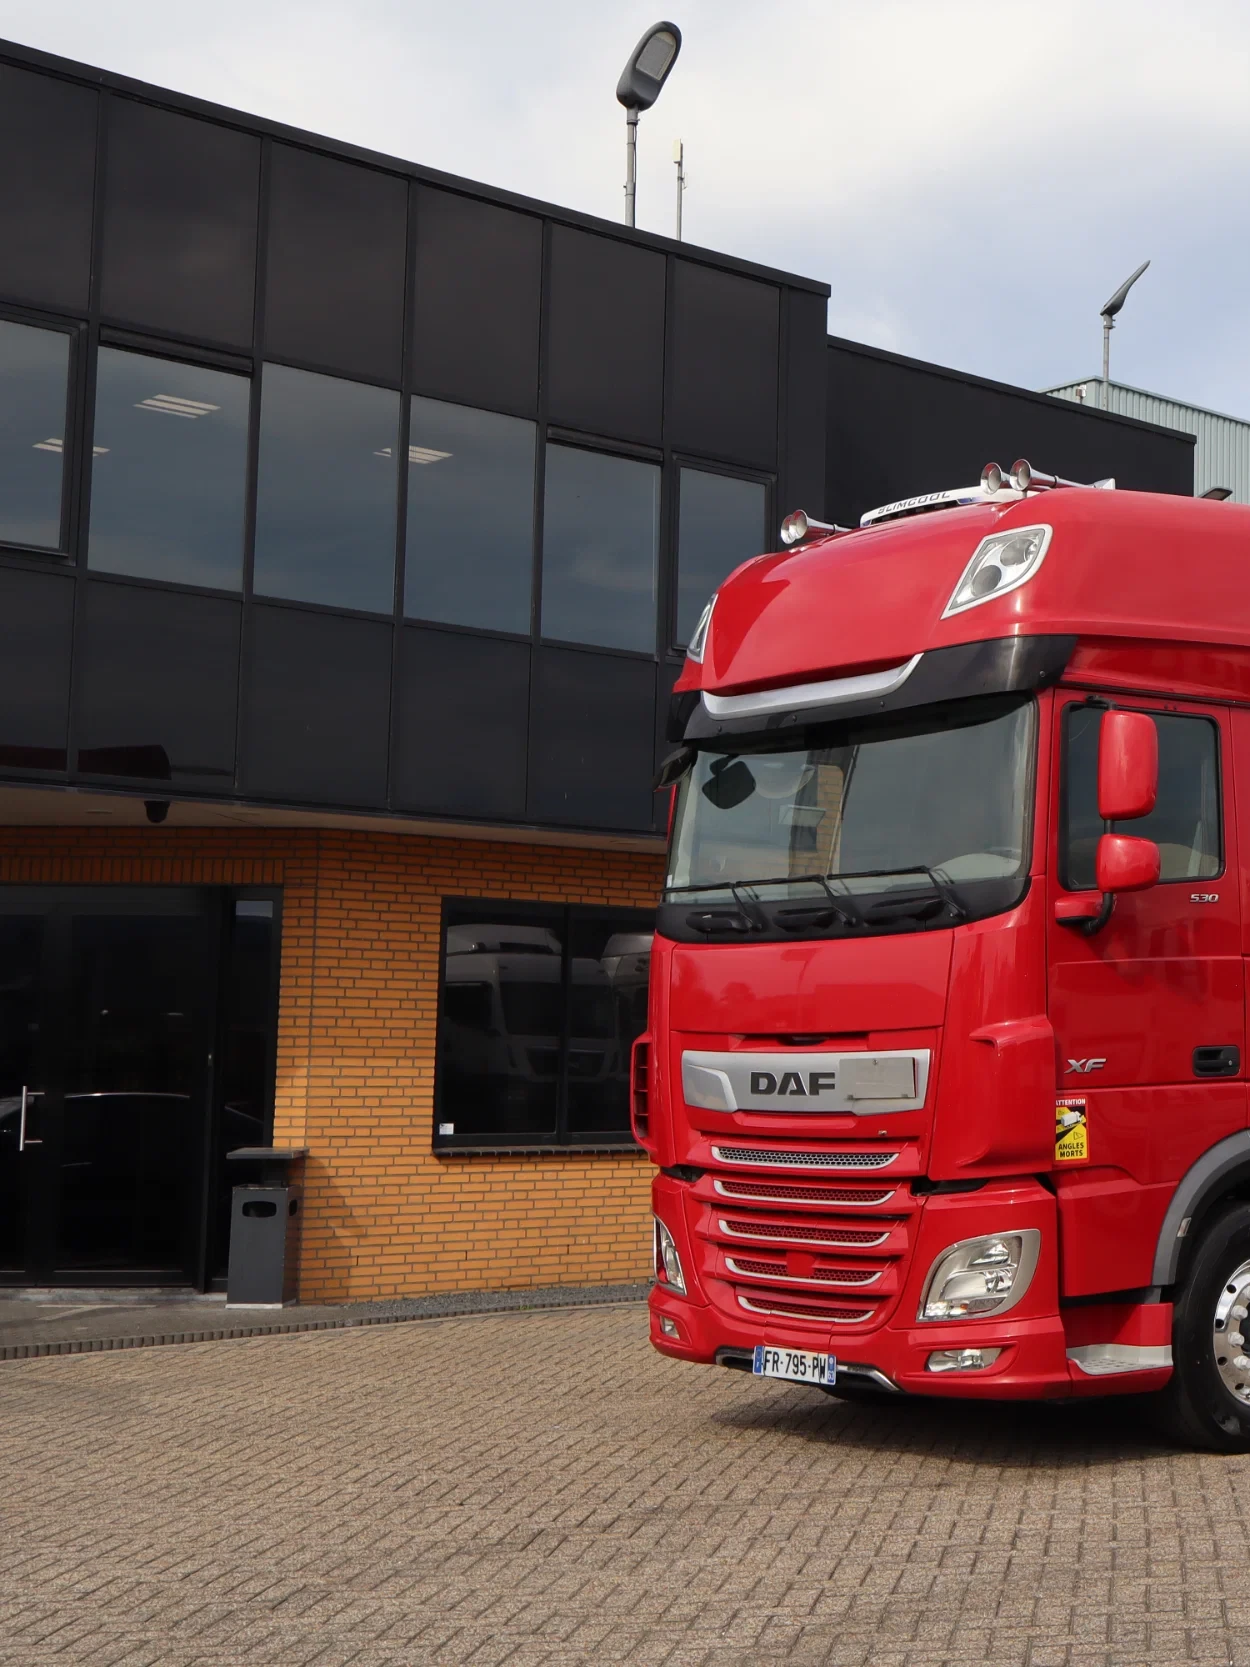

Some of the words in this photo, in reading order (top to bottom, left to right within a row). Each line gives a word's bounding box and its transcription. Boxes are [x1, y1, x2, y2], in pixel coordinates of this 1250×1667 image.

[877, 492, 950, 514] SLIMCOOL
[1189, 893, 1219, 903] 530
[1063, 1058, 1107, 1074] XF
[750, 1071, 836, 1096] DAF
[1058, 1142, 1085, 1150] ANGLES
[1059, 1150, 1084, 1158] MORTS
[763, 1350, 827, 1379] FR-795-PW
